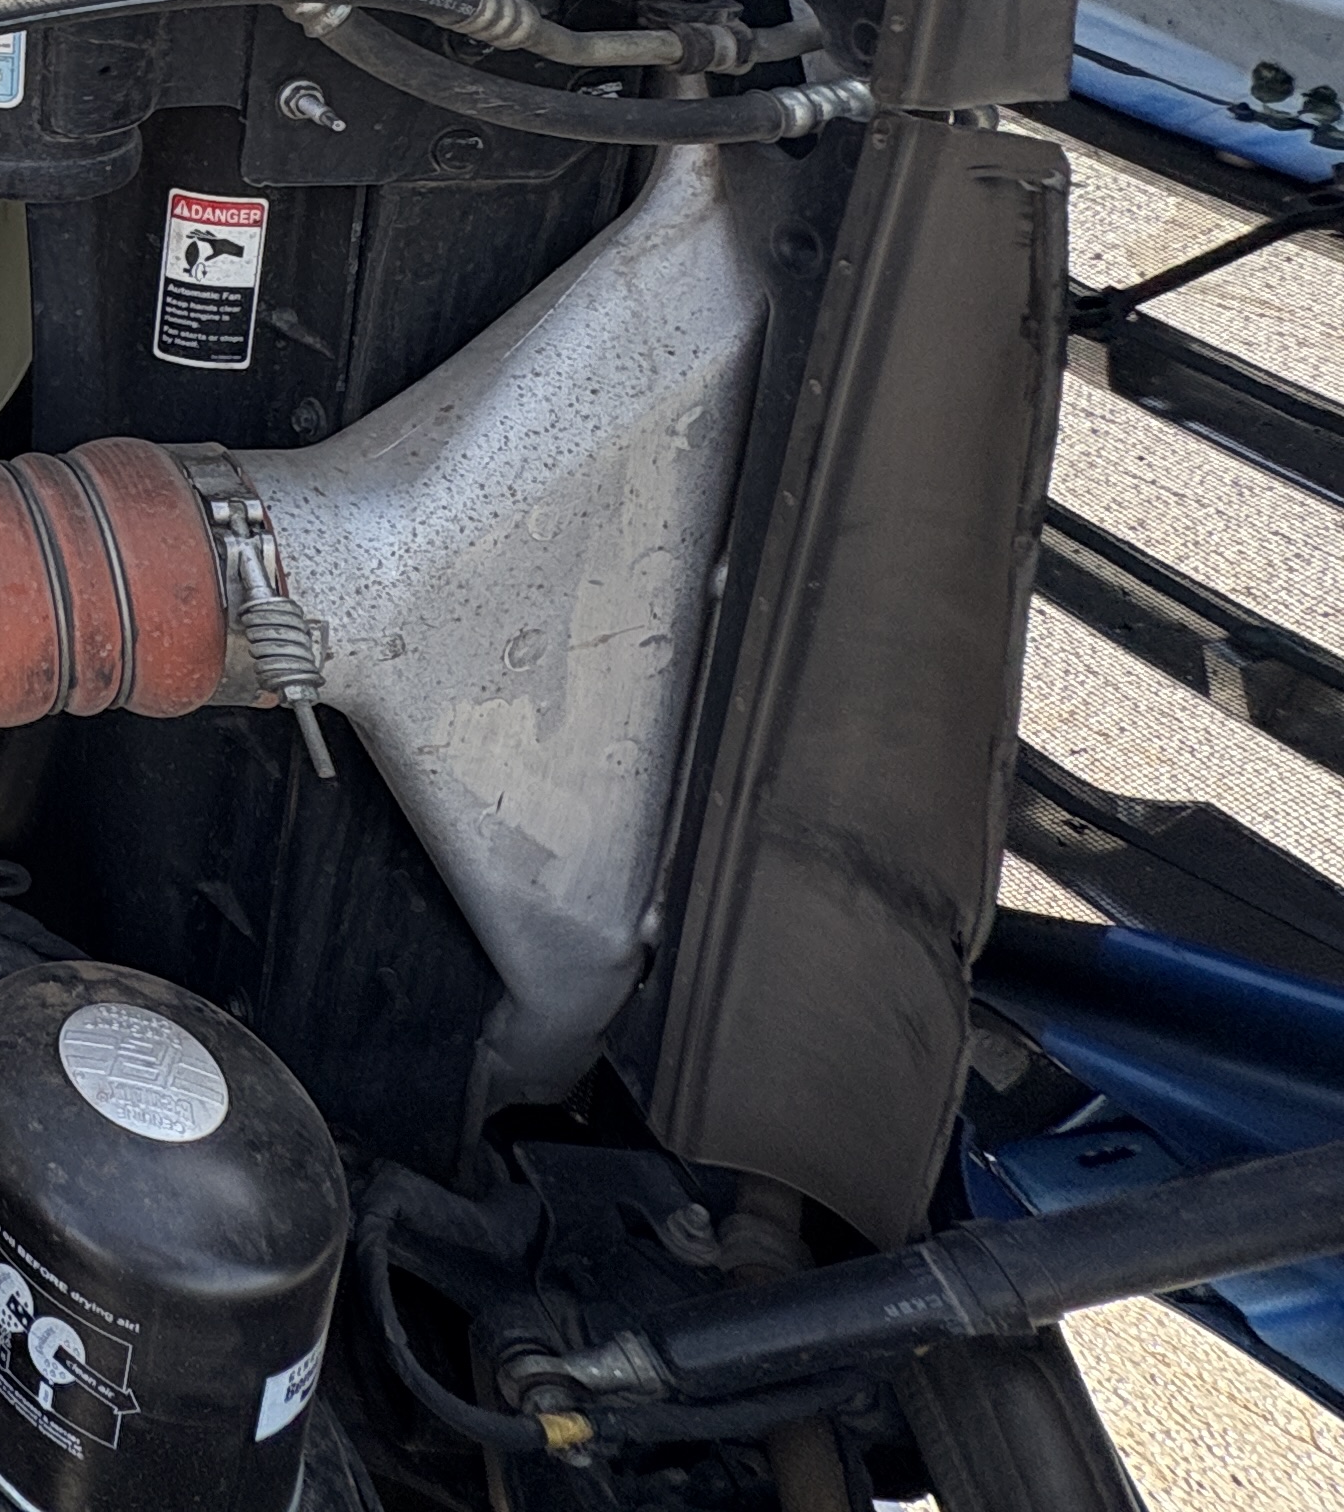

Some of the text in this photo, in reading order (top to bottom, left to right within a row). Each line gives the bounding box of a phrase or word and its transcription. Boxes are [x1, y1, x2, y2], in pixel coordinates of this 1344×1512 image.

[191, 205, 262, 225] DANGER
[167, 283, 242, 300] Automatic Fan
[166, 296, 242, 313] Keep hands clear
[165, 306, 188, 316] when
[189, 312, 221, 321] engine
[163, 325, 179, 336] Fan
[180, 331, 207, 341] starts
[17, 1245, 69, 1294] BEFORE
[70, 1291, 114, 1324] drying
[64, 1357, 115, 1399] clean air
